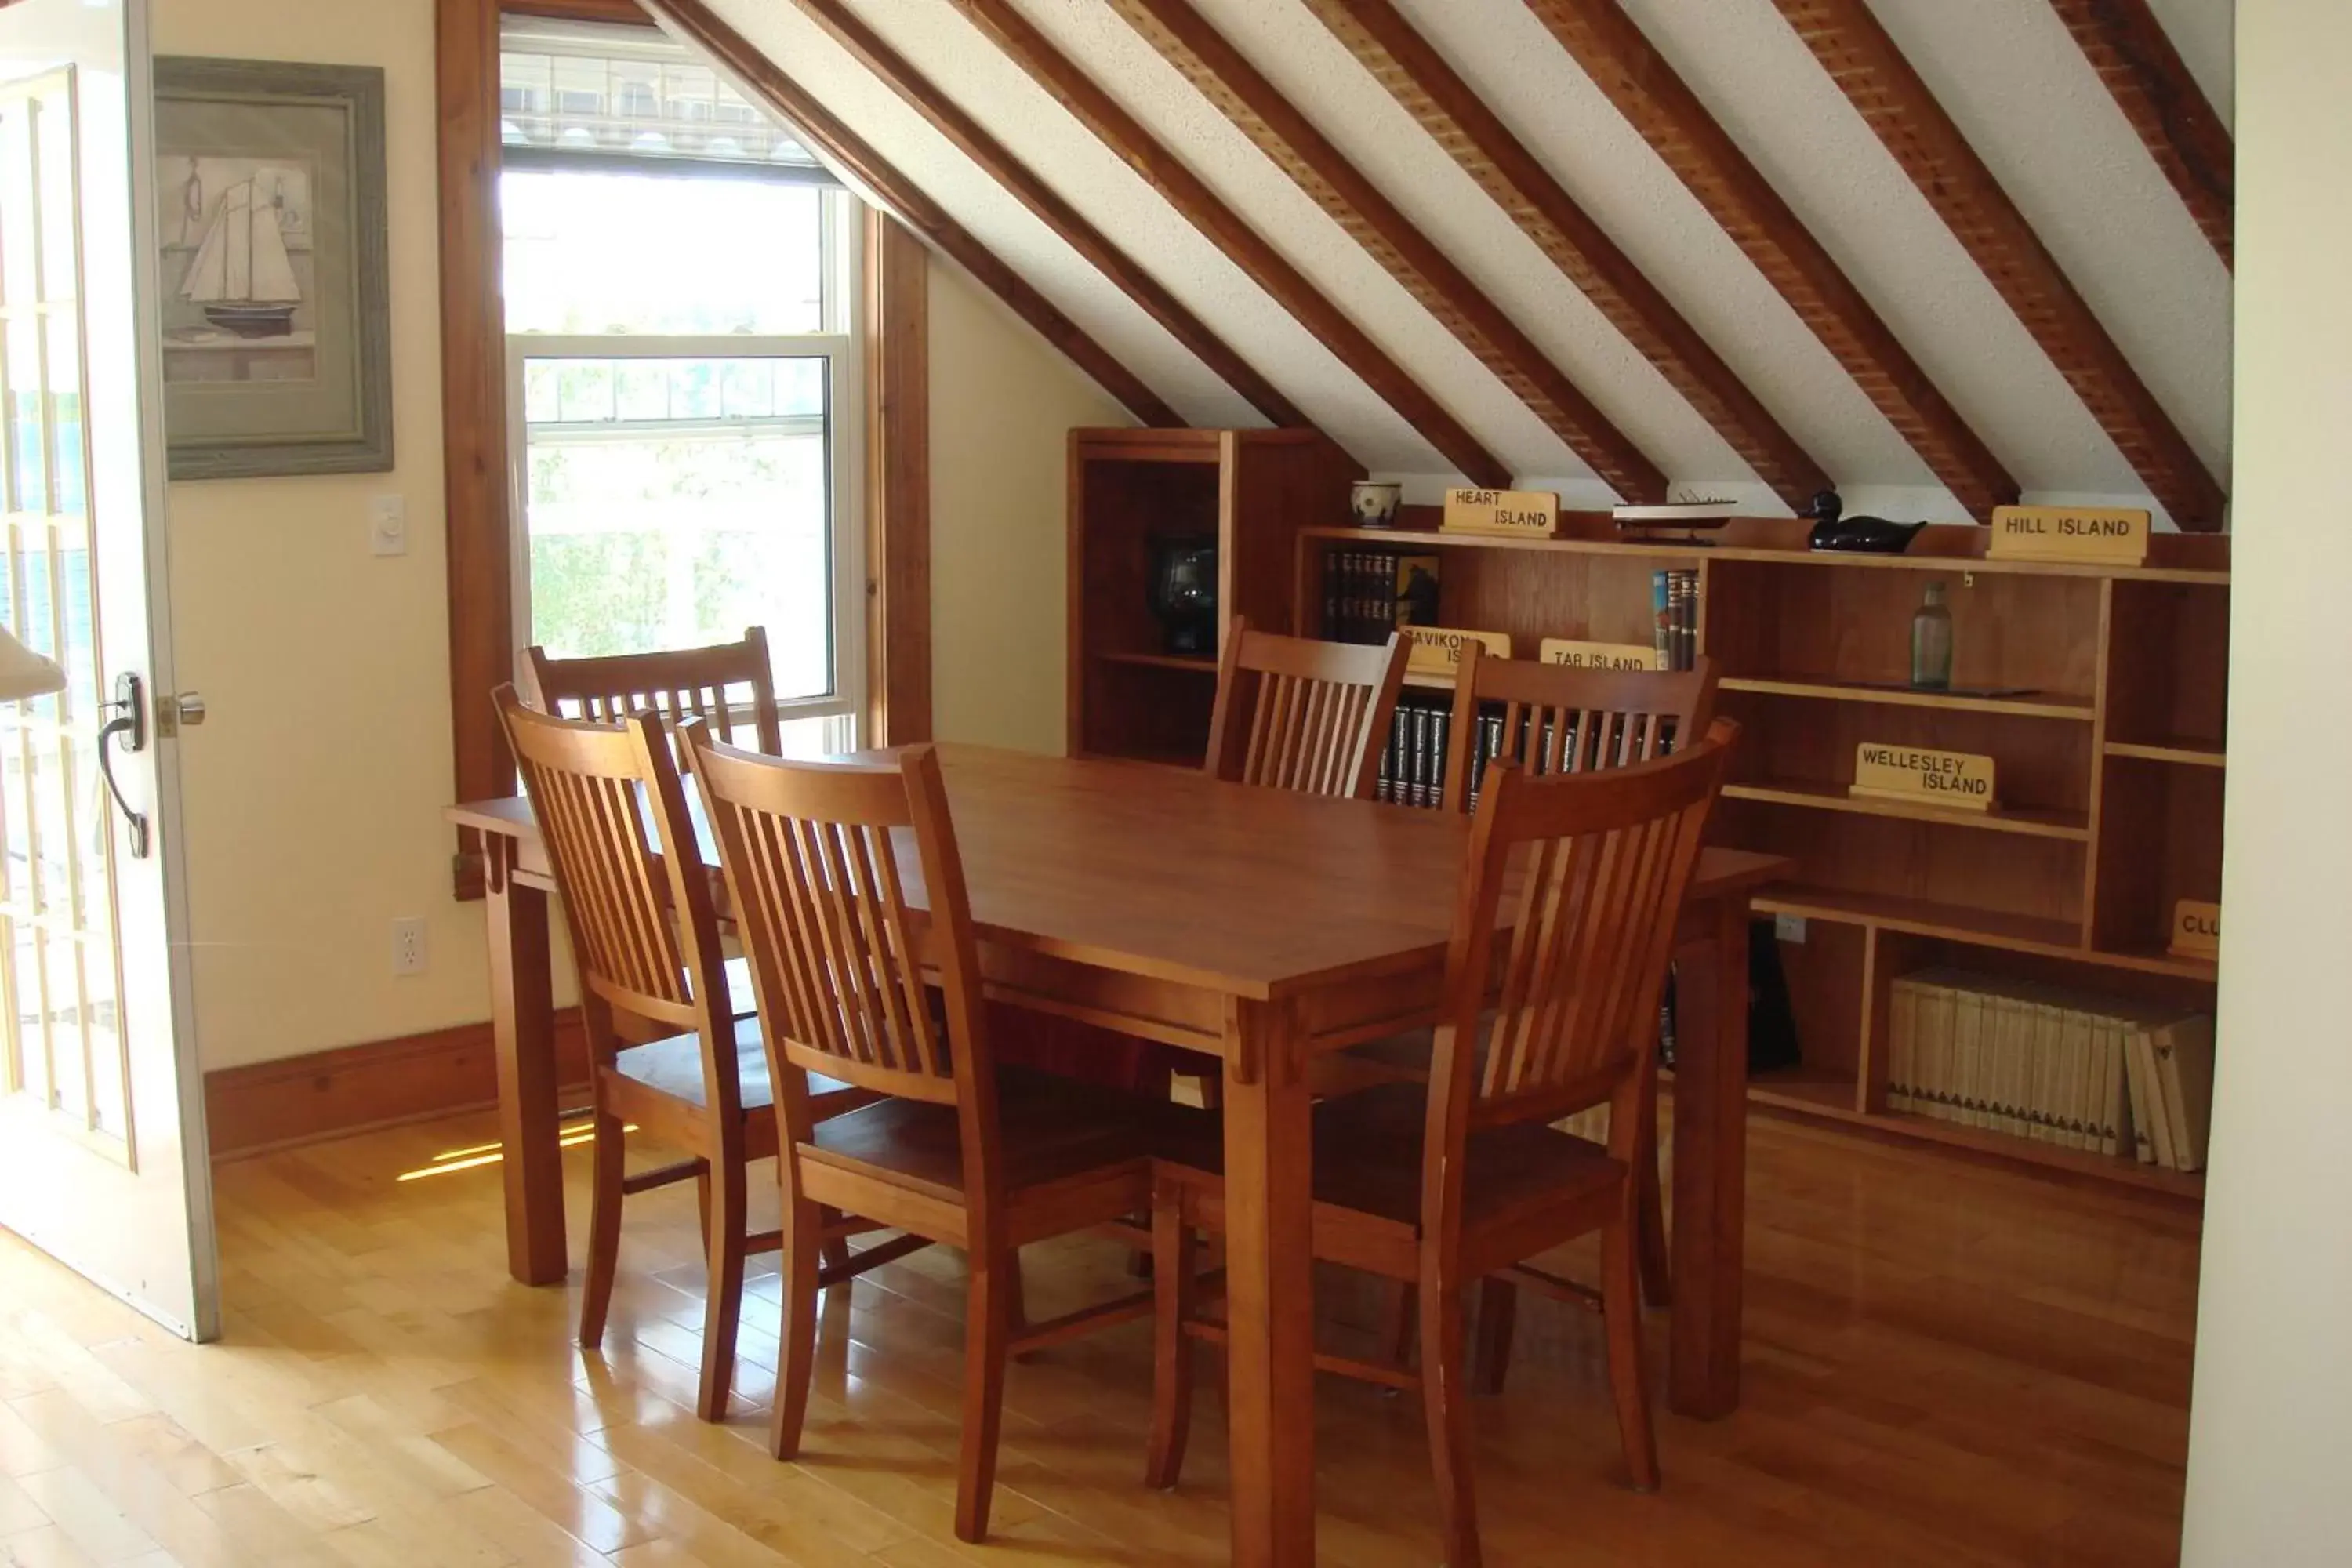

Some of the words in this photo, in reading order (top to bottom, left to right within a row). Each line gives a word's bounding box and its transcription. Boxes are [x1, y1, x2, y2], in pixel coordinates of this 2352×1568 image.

[1455, 490, 1502, 506] HEART
[1494, 510, 1547, 527] ISLAND
[2005, 517, 2047, 534] HILL
[2057, 518, 2131, 536] ISLAND
[1404, 630, 1470, 649] AVIKO
[1555, 652, 1582, 668] TAR
[1588, 654, 1643, 673] ISLAND
[1863, 749, 1965, 775] WELLESLEY
[1922, 772, 1987, 795] ISLAND
